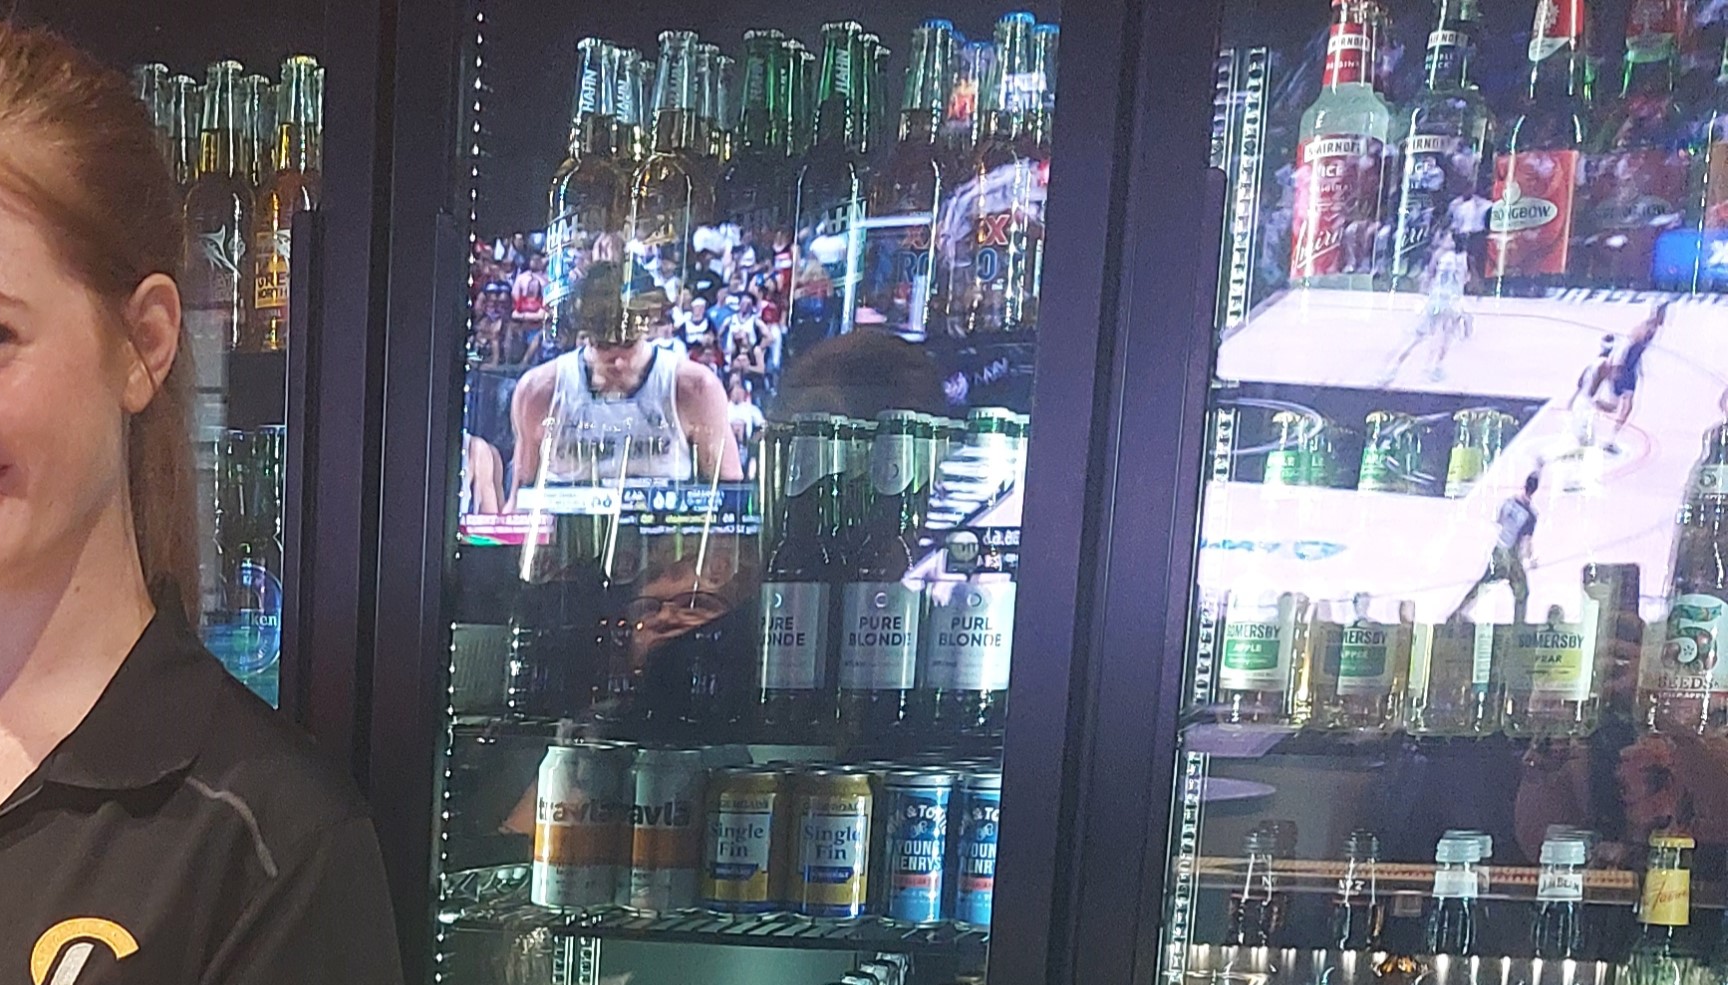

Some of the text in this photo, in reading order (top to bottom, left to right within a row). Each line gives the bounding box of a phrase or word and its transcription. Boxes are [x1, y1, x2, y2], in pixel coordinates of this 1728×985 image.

[834, 48, 850, 94] HAHN
[582, 69, 598, 113] HAHN
[1319, 163, 1345, 178] ICE
[859, 616, 902, 631] PURE
[1227, 623, 1282, 639] SOMERSBY
[849, 632, 912, 647] BLONDE
[938, 633, 1003, 648] BLONDE
[1517, 632, 1585, 650] SOMERSBY
[1657, 675, 1715, 690] SEEDS
[712, 822, 765, 843] Single
[804, 825, 862, 845] Single
[719, 842, 749, 858] Fin
[815, 844, 847, 861] Fin
[1540, 876, 1558, 893] JIM
